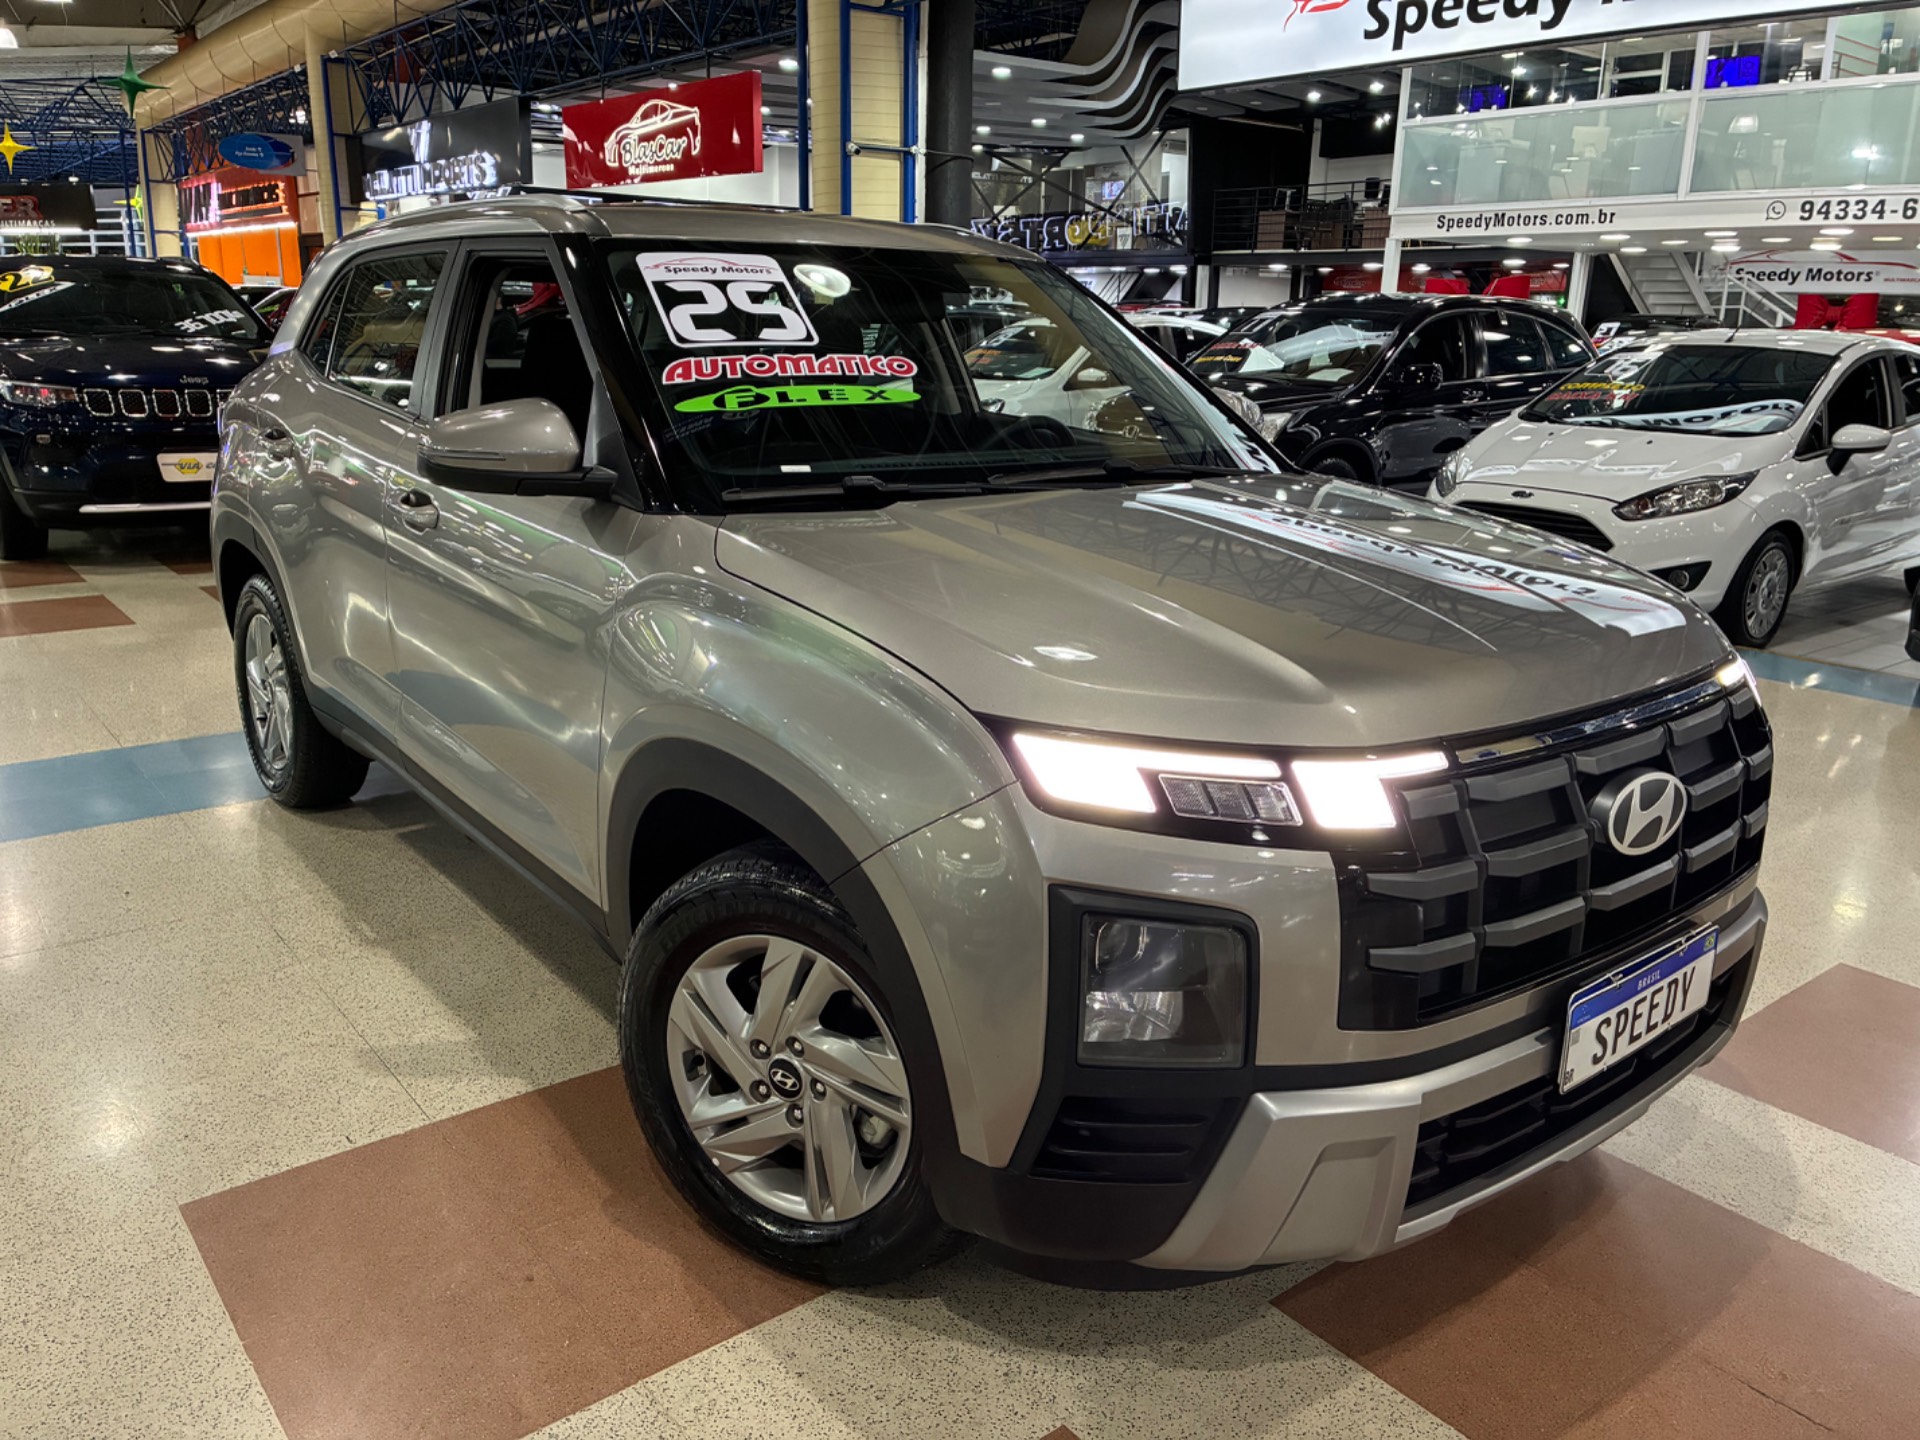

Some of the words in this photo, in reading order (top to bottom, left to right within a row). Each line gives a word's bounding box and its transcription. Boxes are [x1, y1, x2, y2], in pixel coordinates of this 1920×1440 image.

[1437, 208, 1616, 232] SpeedyMotors.com.br
[1800, 198, 1919, 221] 94334-6
[664, 265, 717, 275] Speedy
[721, 265, 773, 275] Motors
[1805, 267, 1874, 282] Motors
[664, 281, 808, 341] 25
[662, 354, 919, 385] AUTOMATICO
[713, 386, 890, 411] FLEX
[1637, 969, 1661, 991] BRASIL
[1592, 965, 1696, 1066] SPEEDY
